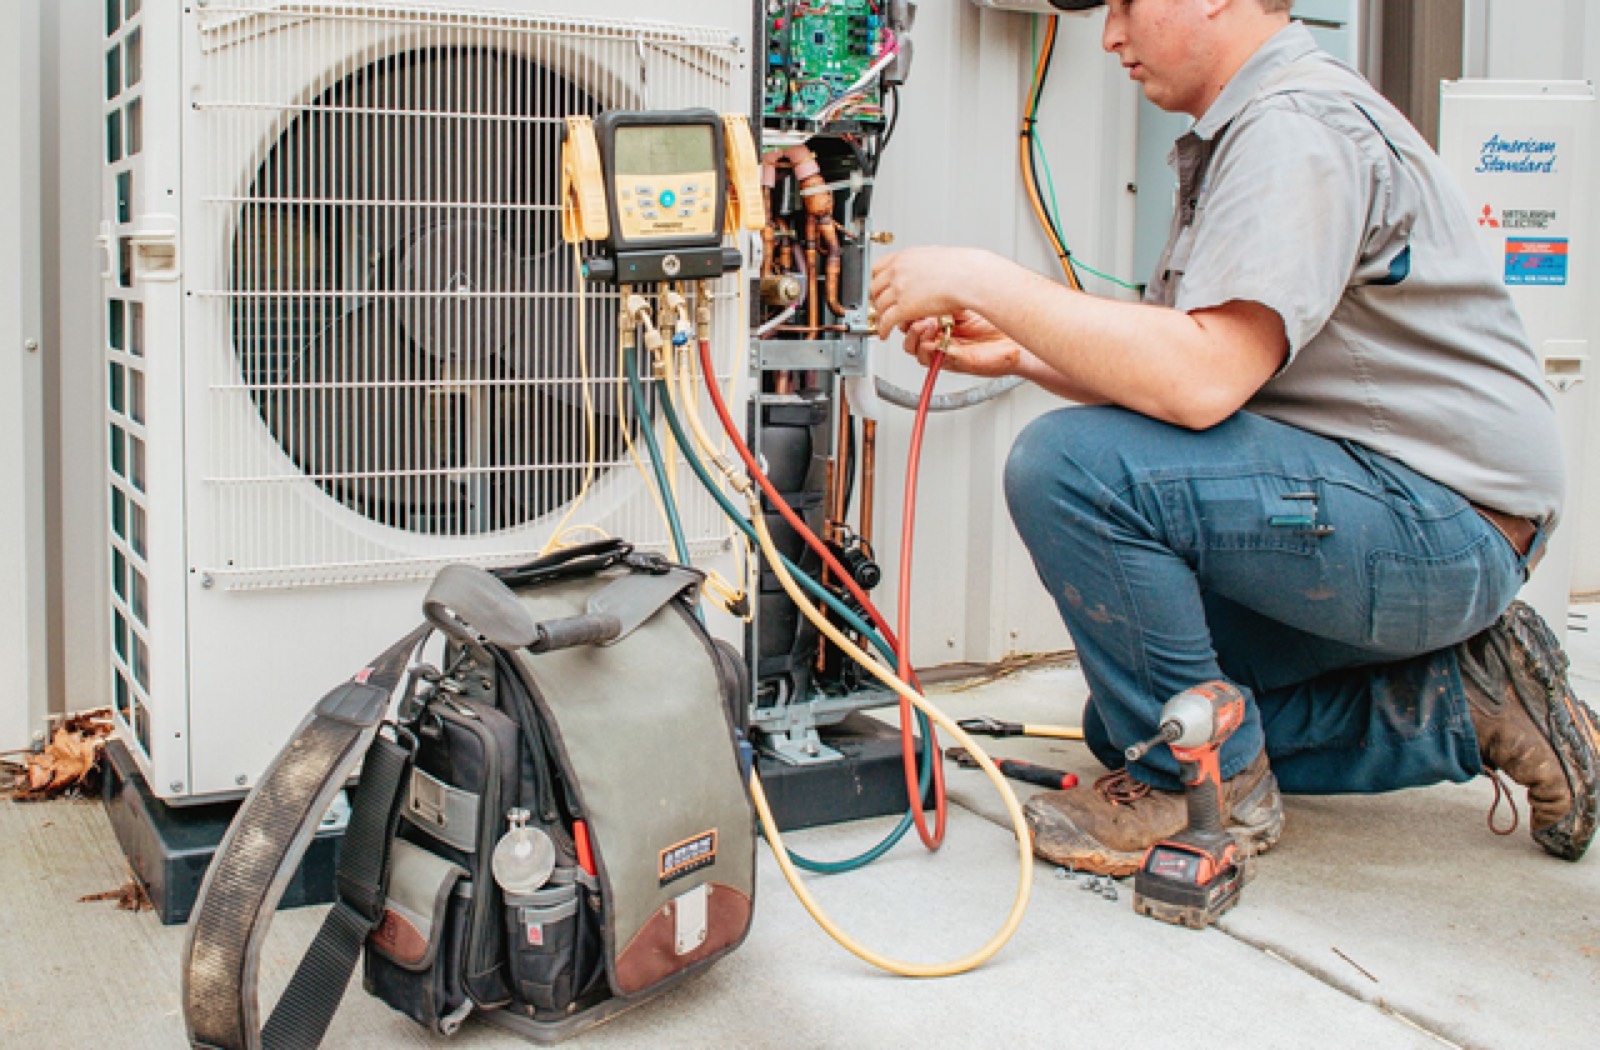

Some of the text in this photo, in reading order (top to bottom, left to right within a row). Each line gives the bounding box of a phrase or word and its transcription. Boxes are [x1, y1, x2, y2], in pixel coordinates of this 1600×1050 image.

[1481, 134, 1556, 153] American
[1475, 155, 1557, 173] Standard
[1502, 209, 1555, 220] MITSUBISHI
[1502, 219, 1548, 229] ELECTRIC
